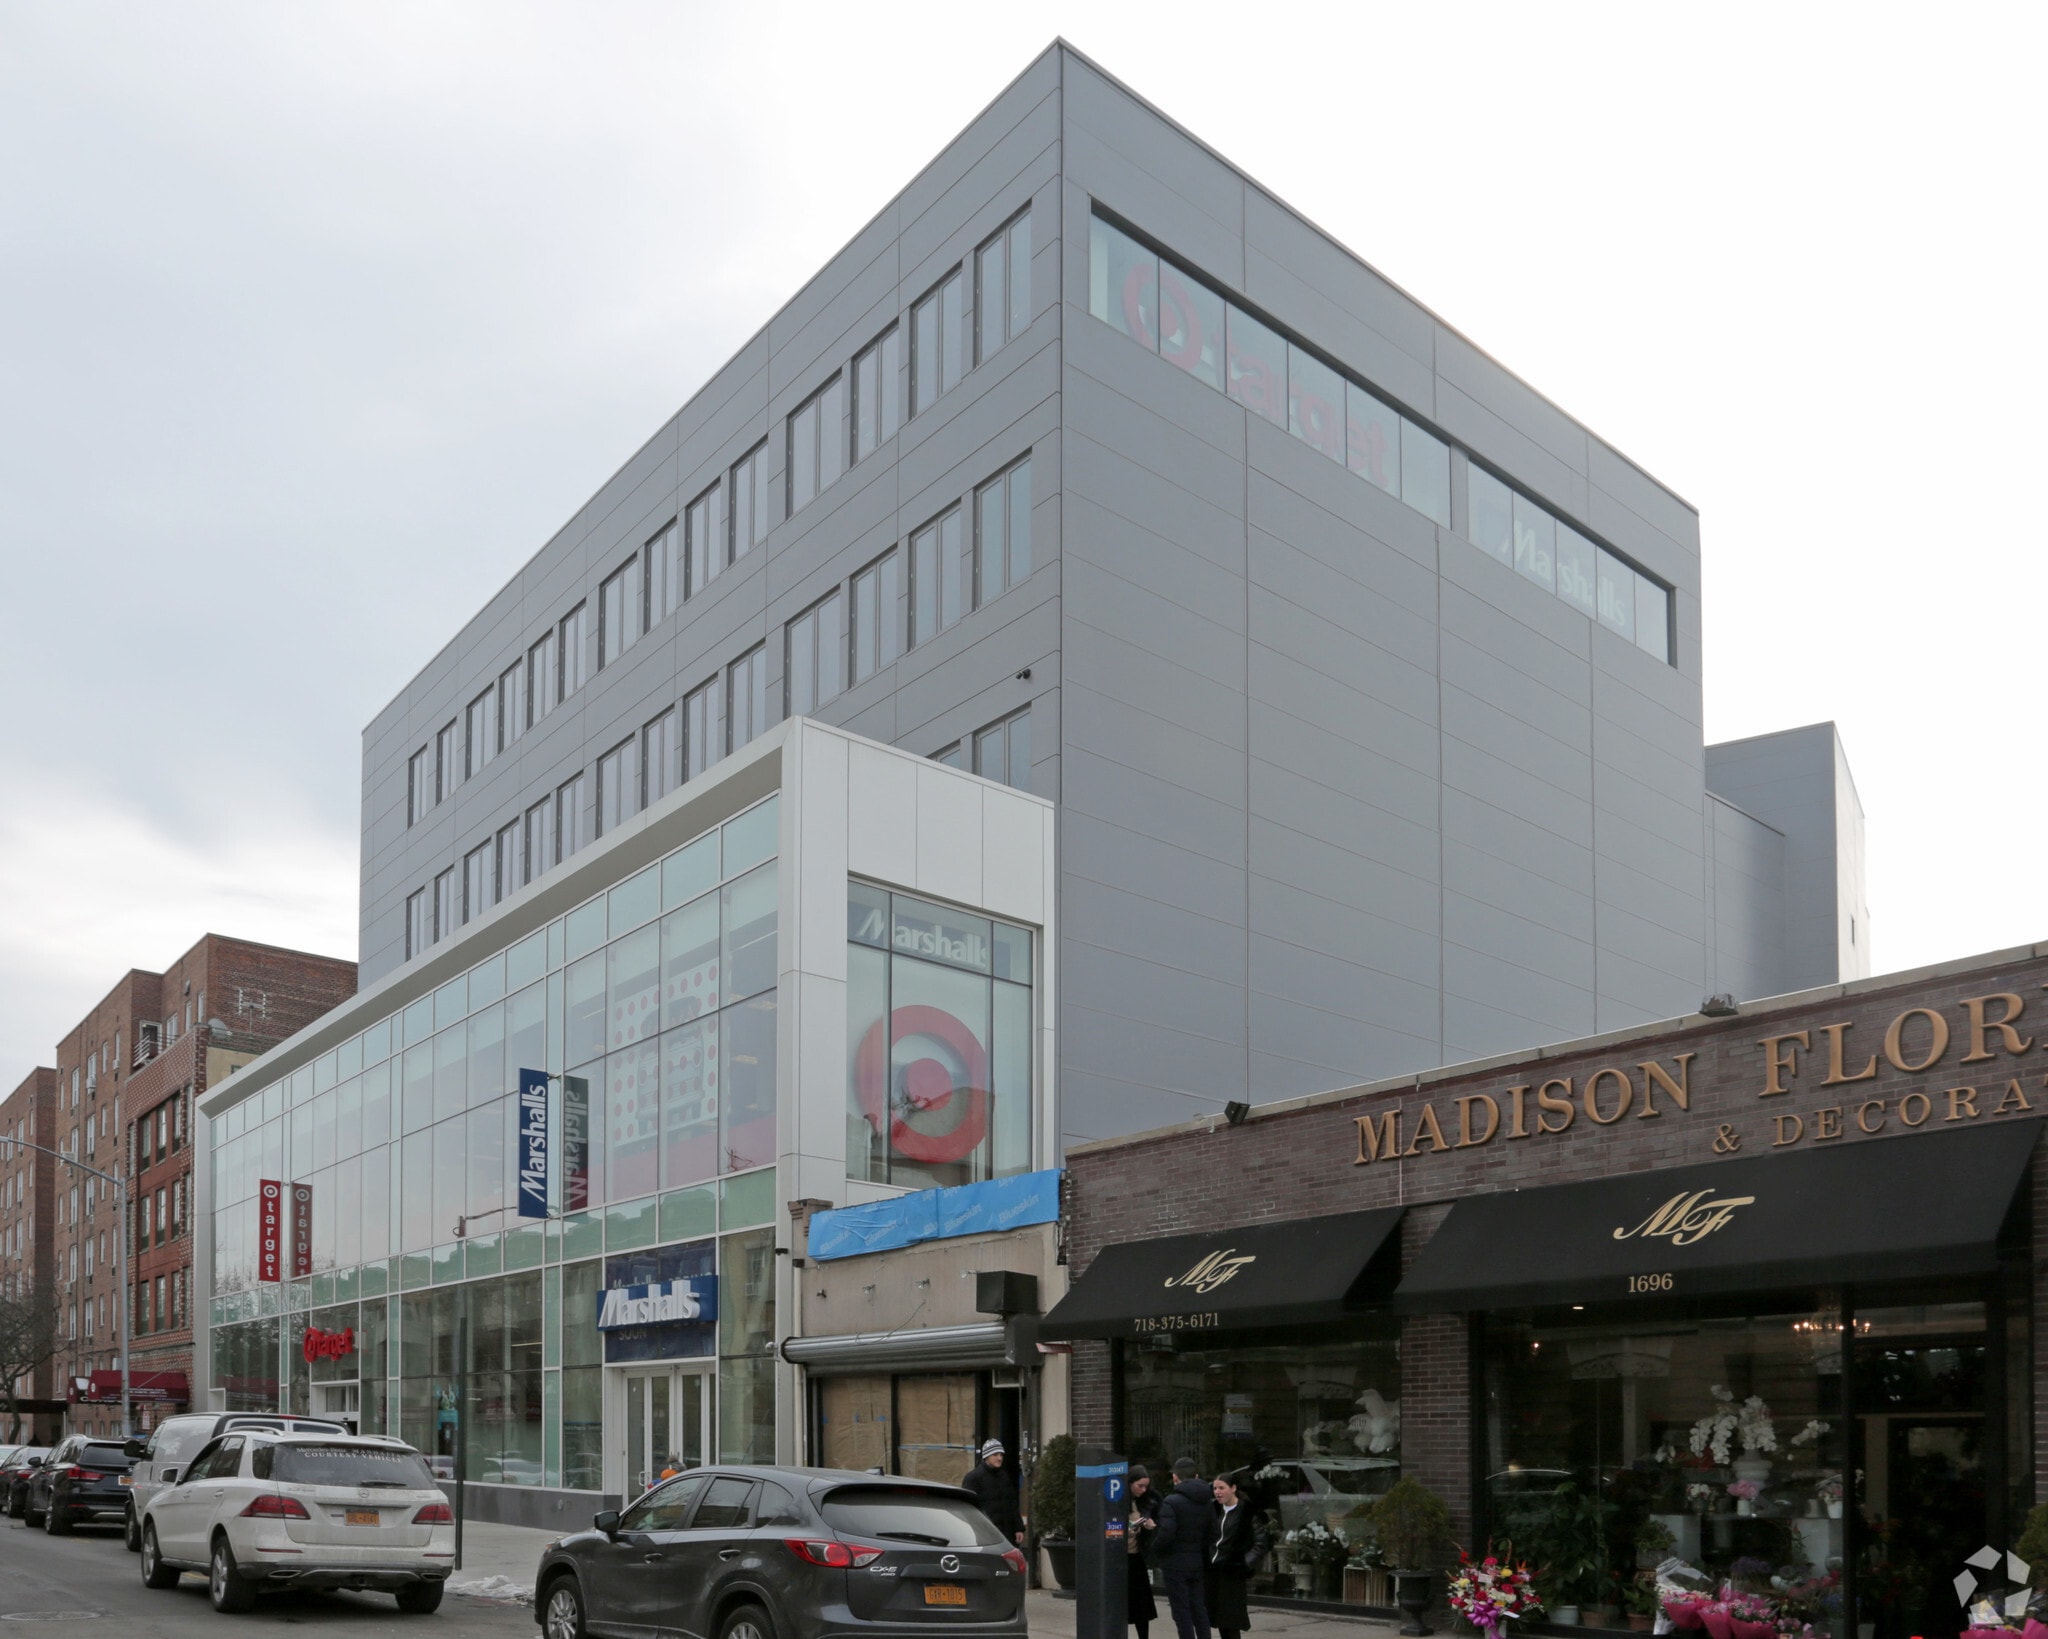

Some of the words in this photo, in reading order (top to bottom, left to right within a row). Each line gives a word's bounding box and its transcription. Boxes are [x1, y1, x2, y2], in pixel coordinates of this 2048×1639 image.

[1353, 1053, 1696, 1165] MADISON
[1757, 984, 2048, 1098] FLOR
[1712, 1123, 1742, 1155] &
[1771, 1074, 2048, 1148] DECORA
[521, 1084, 546, 1203] Marshalls
[265, 1201, 275, 1277] target
[598, 1279, 701, 1328] Marshalls
[1628, 1273, 1673, 1293] 1696
[1134, 1312, 1219, 1332] 718-375-6171
[361, 1453, 402, 1464] VEHICLE
[1110, 1479, 1120, 1499] P
